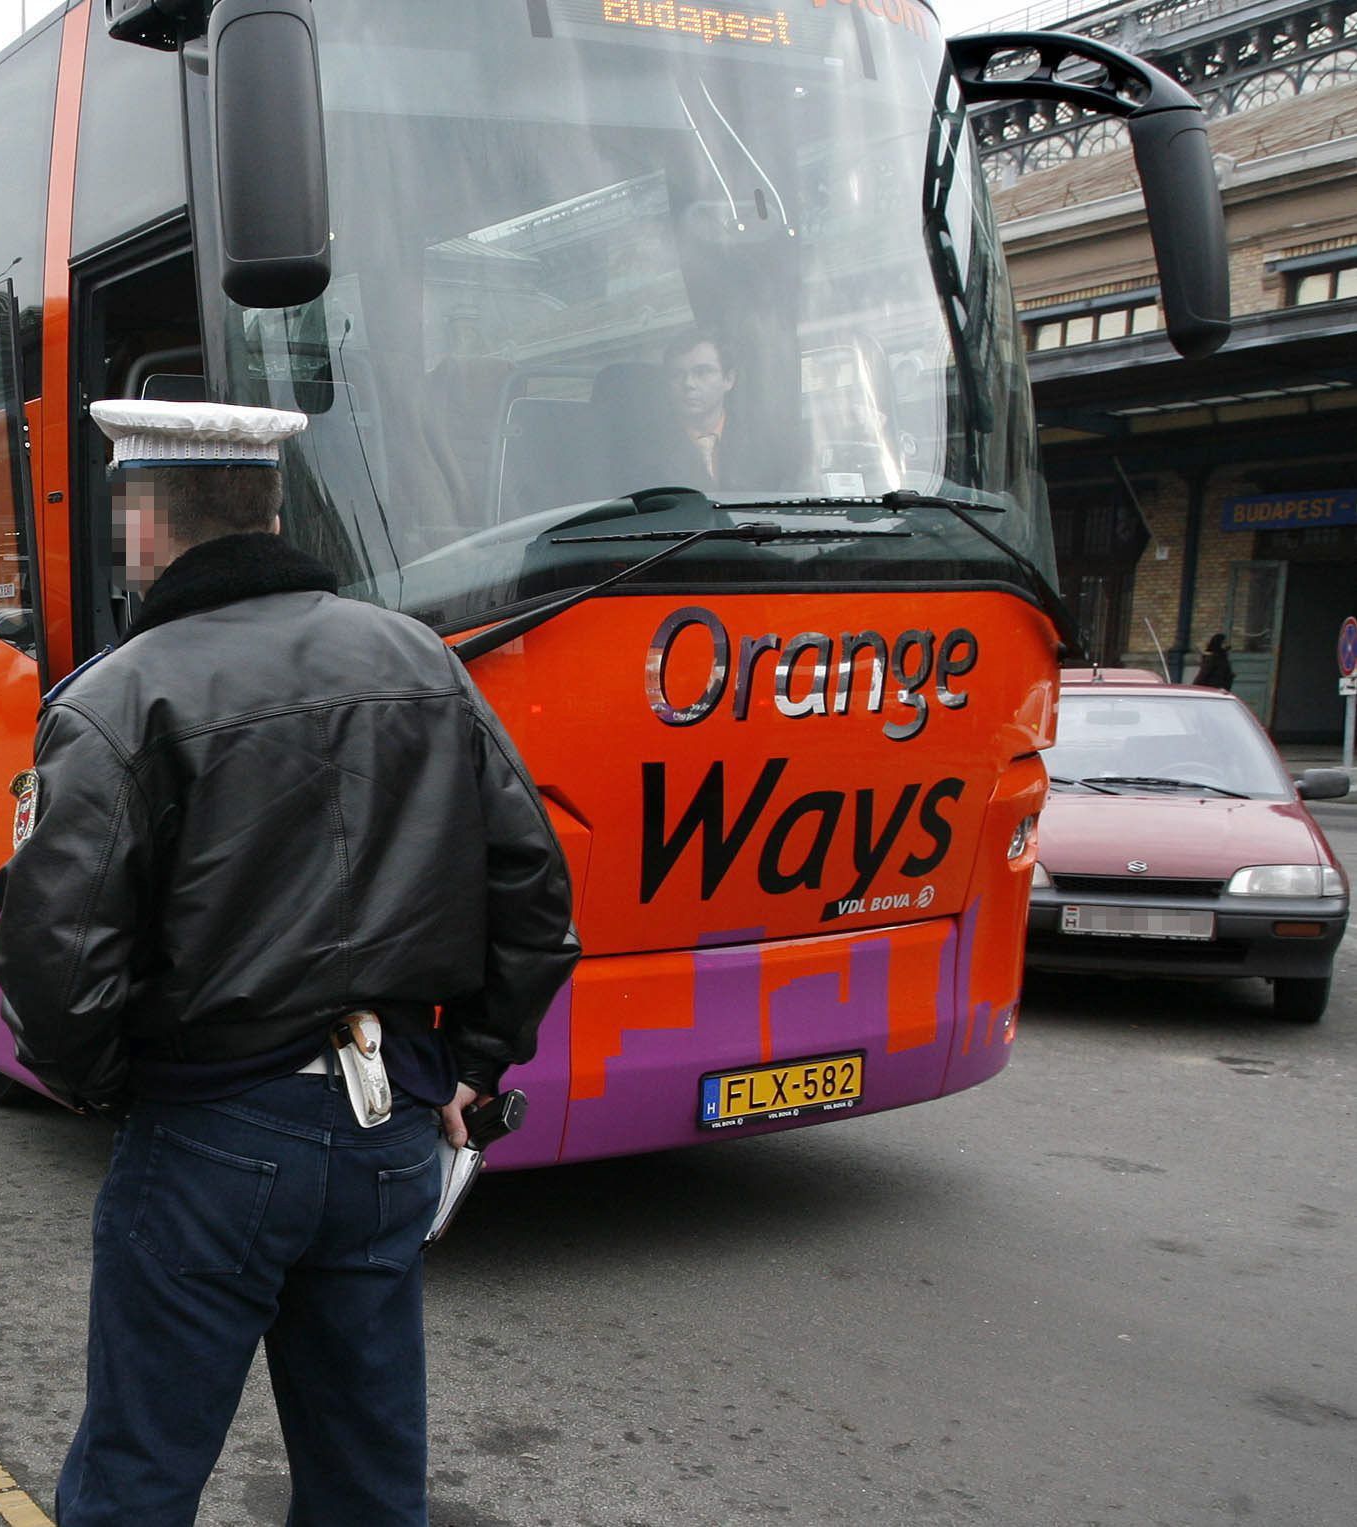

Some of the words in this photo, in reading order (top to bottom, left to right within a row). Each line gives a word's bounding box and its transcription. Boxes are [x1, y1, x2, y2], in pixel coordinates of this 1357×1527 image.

[602, 0, 791, 44] Budapest
[1234, 498, 1337, 522] BUDAPEST
[645, 606, 979, 742] Orange
[639, 757, 966, 921] Ways
[838, 898, 866, 915] VDL
[870, 893, 910, 911] BOVA
[1065, 917, 1077, 928] H
[726, 1062, 854, 1113] FLX-582
[707, 1102, 716, 1114] H
